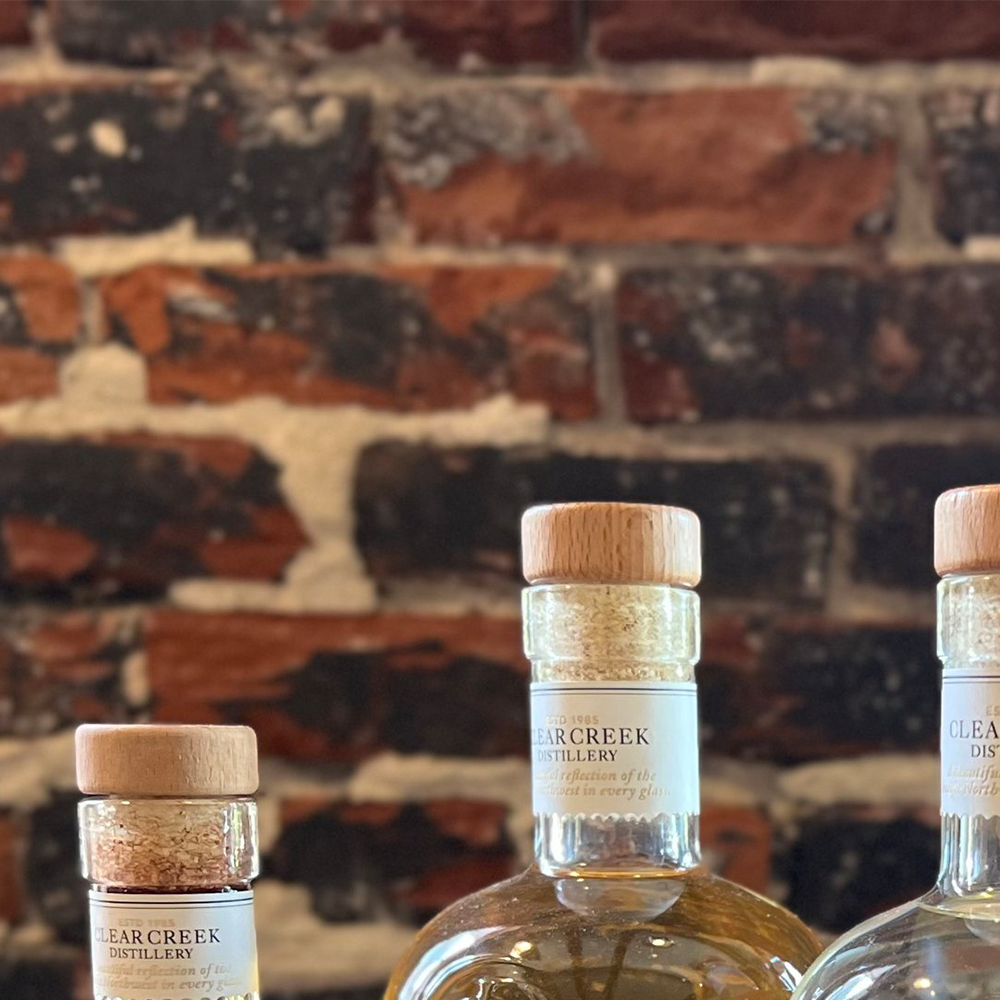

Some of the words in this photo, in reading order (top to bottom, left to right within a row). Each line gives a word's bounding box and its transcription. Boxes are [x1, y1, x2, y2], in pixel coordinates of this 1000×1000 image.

[571, 715, 599, 725] 1985
[531, 728, 567, 745] LEAR
[570, 727, 650, 745] CREEK
[538, 750, 618, 762] DISTILLERY
[560, 769, 617, 783] reflection
[620, 770, 634, 785] of
[583, 785, 596, 796] in
[600, 787, 637, 800] every
[147, 928, 221, 945] CREEK
[109, 948, 193, 960] DISTILLERY
